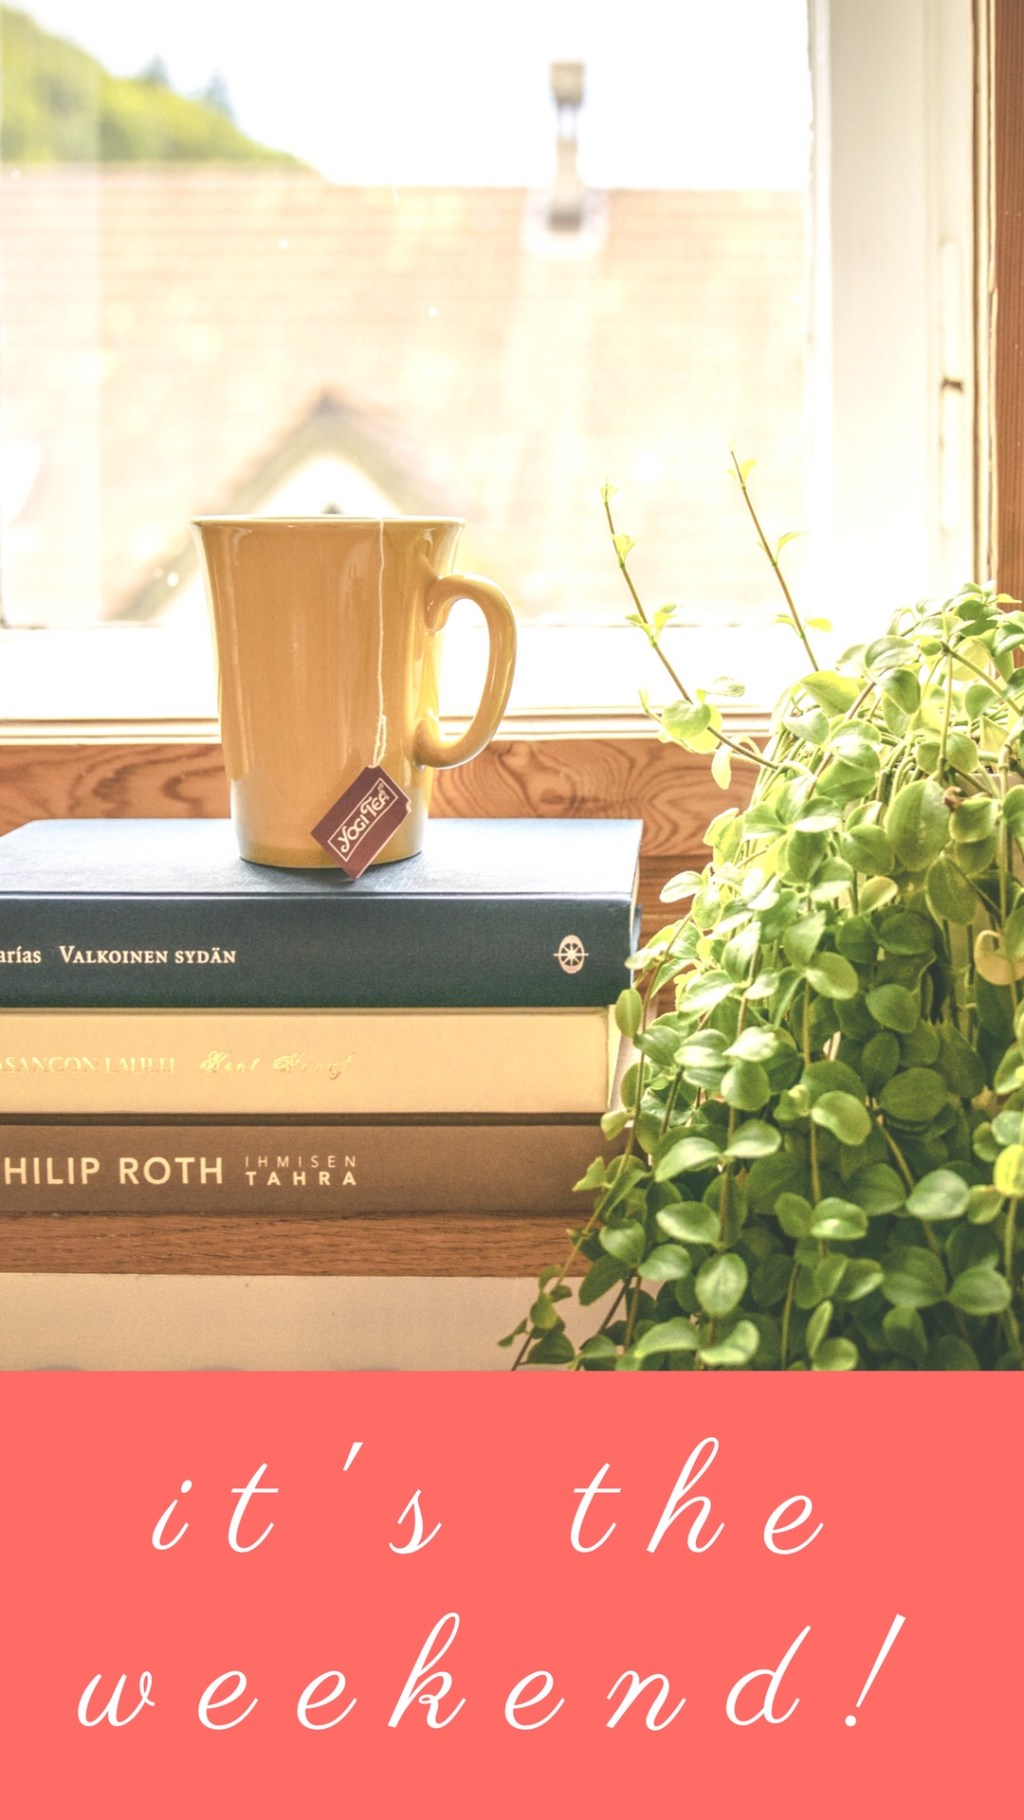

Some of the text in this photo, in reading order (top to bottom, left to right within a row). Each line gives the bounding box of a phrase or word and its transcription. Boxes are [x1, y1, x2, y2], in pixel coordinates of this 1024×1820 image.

[337, 789, 390, 853] YOGI TEA
[58, 945, 168, 964] VALKOINEN
[174, 946, 237, 964] SYDÄN
[119, 1156, 223, 1185] ROTH
[245, 1155, 357, 1168] IHMISEN
[245, 1171, 357, 1186] TAHRA
